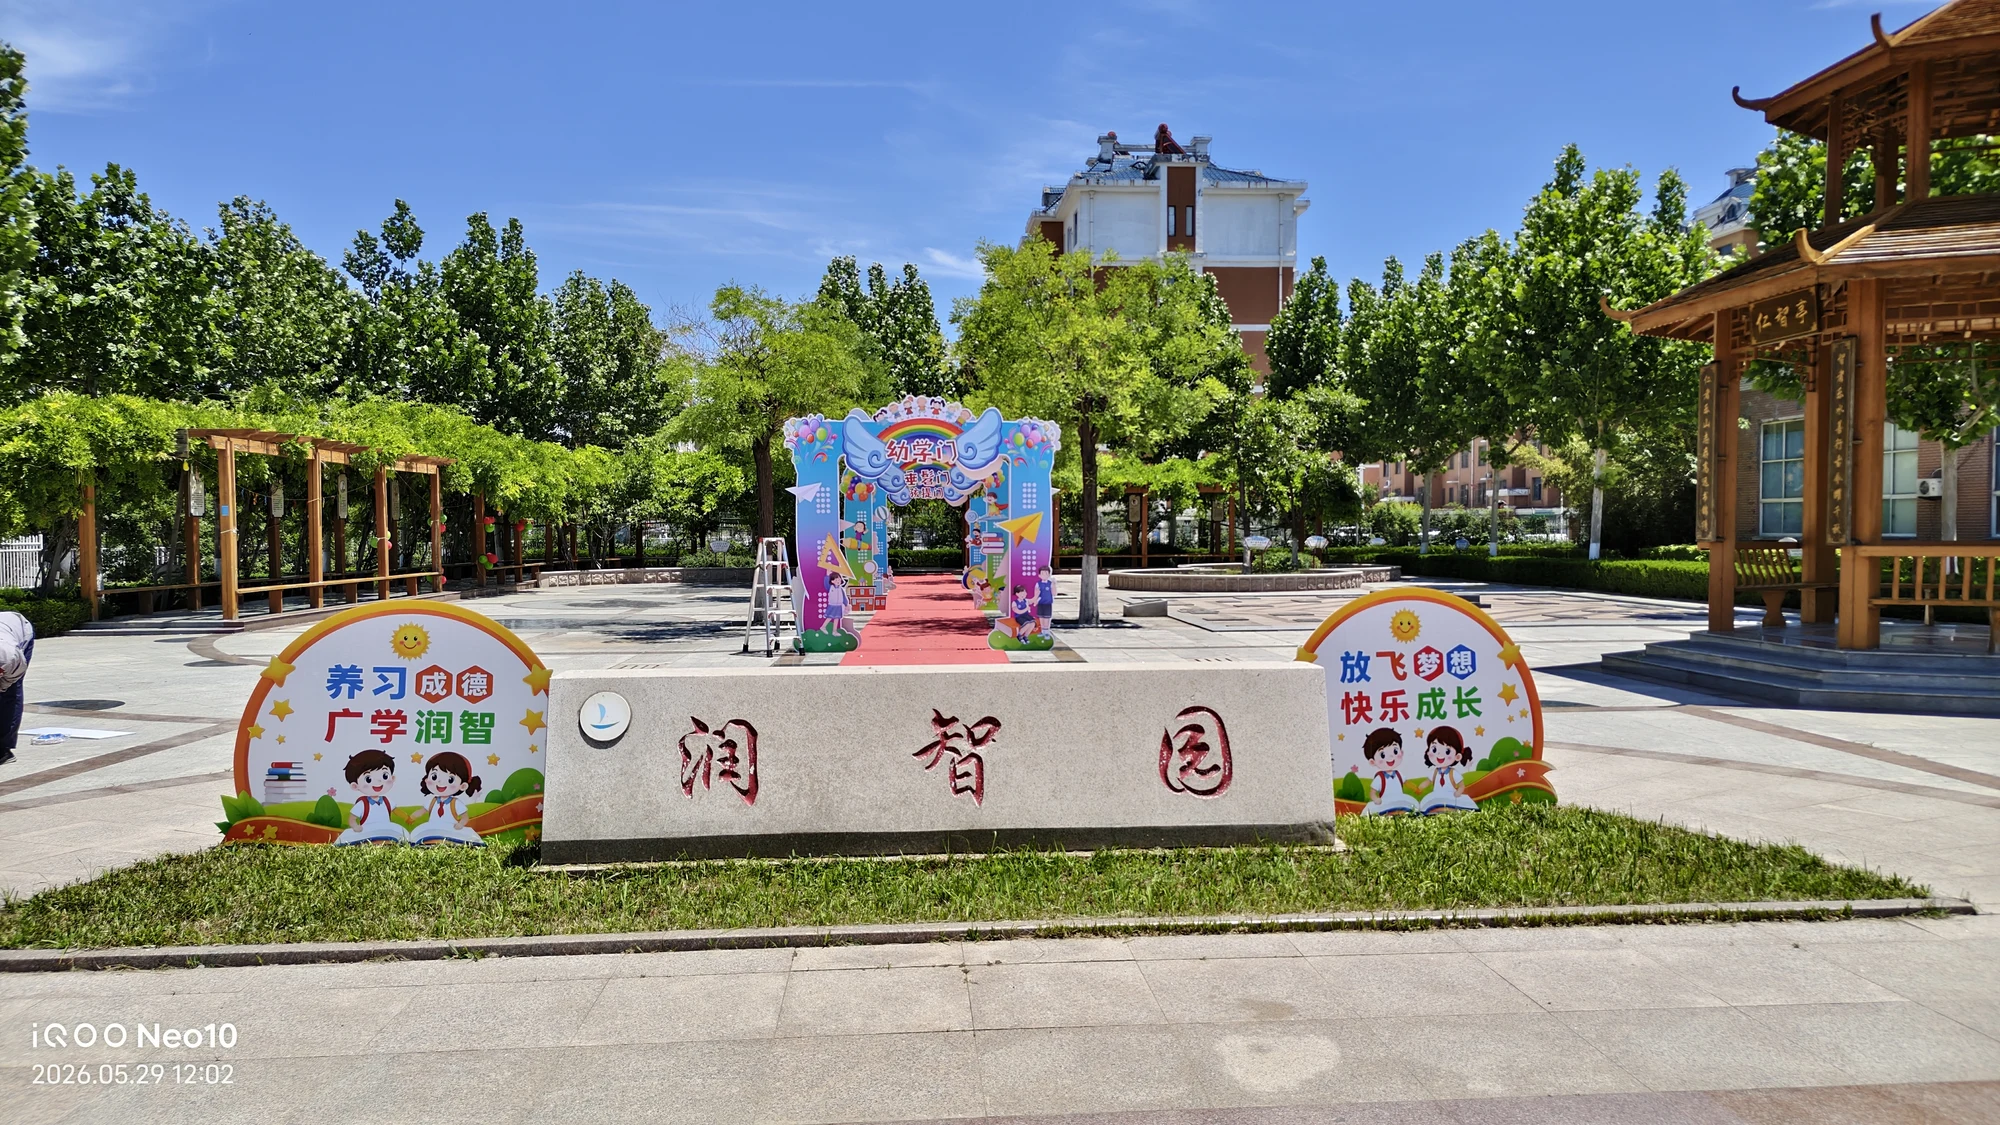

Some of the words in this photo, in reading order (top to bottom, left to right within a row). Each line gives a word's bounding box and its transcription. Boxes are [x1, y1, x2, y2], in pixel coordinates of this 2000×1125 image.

[1756, 299, 1808, 334] 仁智亭
[886, 439, 958, 463] 幼学门
[904, 469, 951, 486] 垂髫门
[326, 664, 488, 700] 养习成德
[1340, 650, 1474, 684] 放飞梦想
[1341, 686, 1483, 726] 快乐成长
[324, 708, 495, 744] 广学润智
[678, 707, 1233, 808] 润智园
